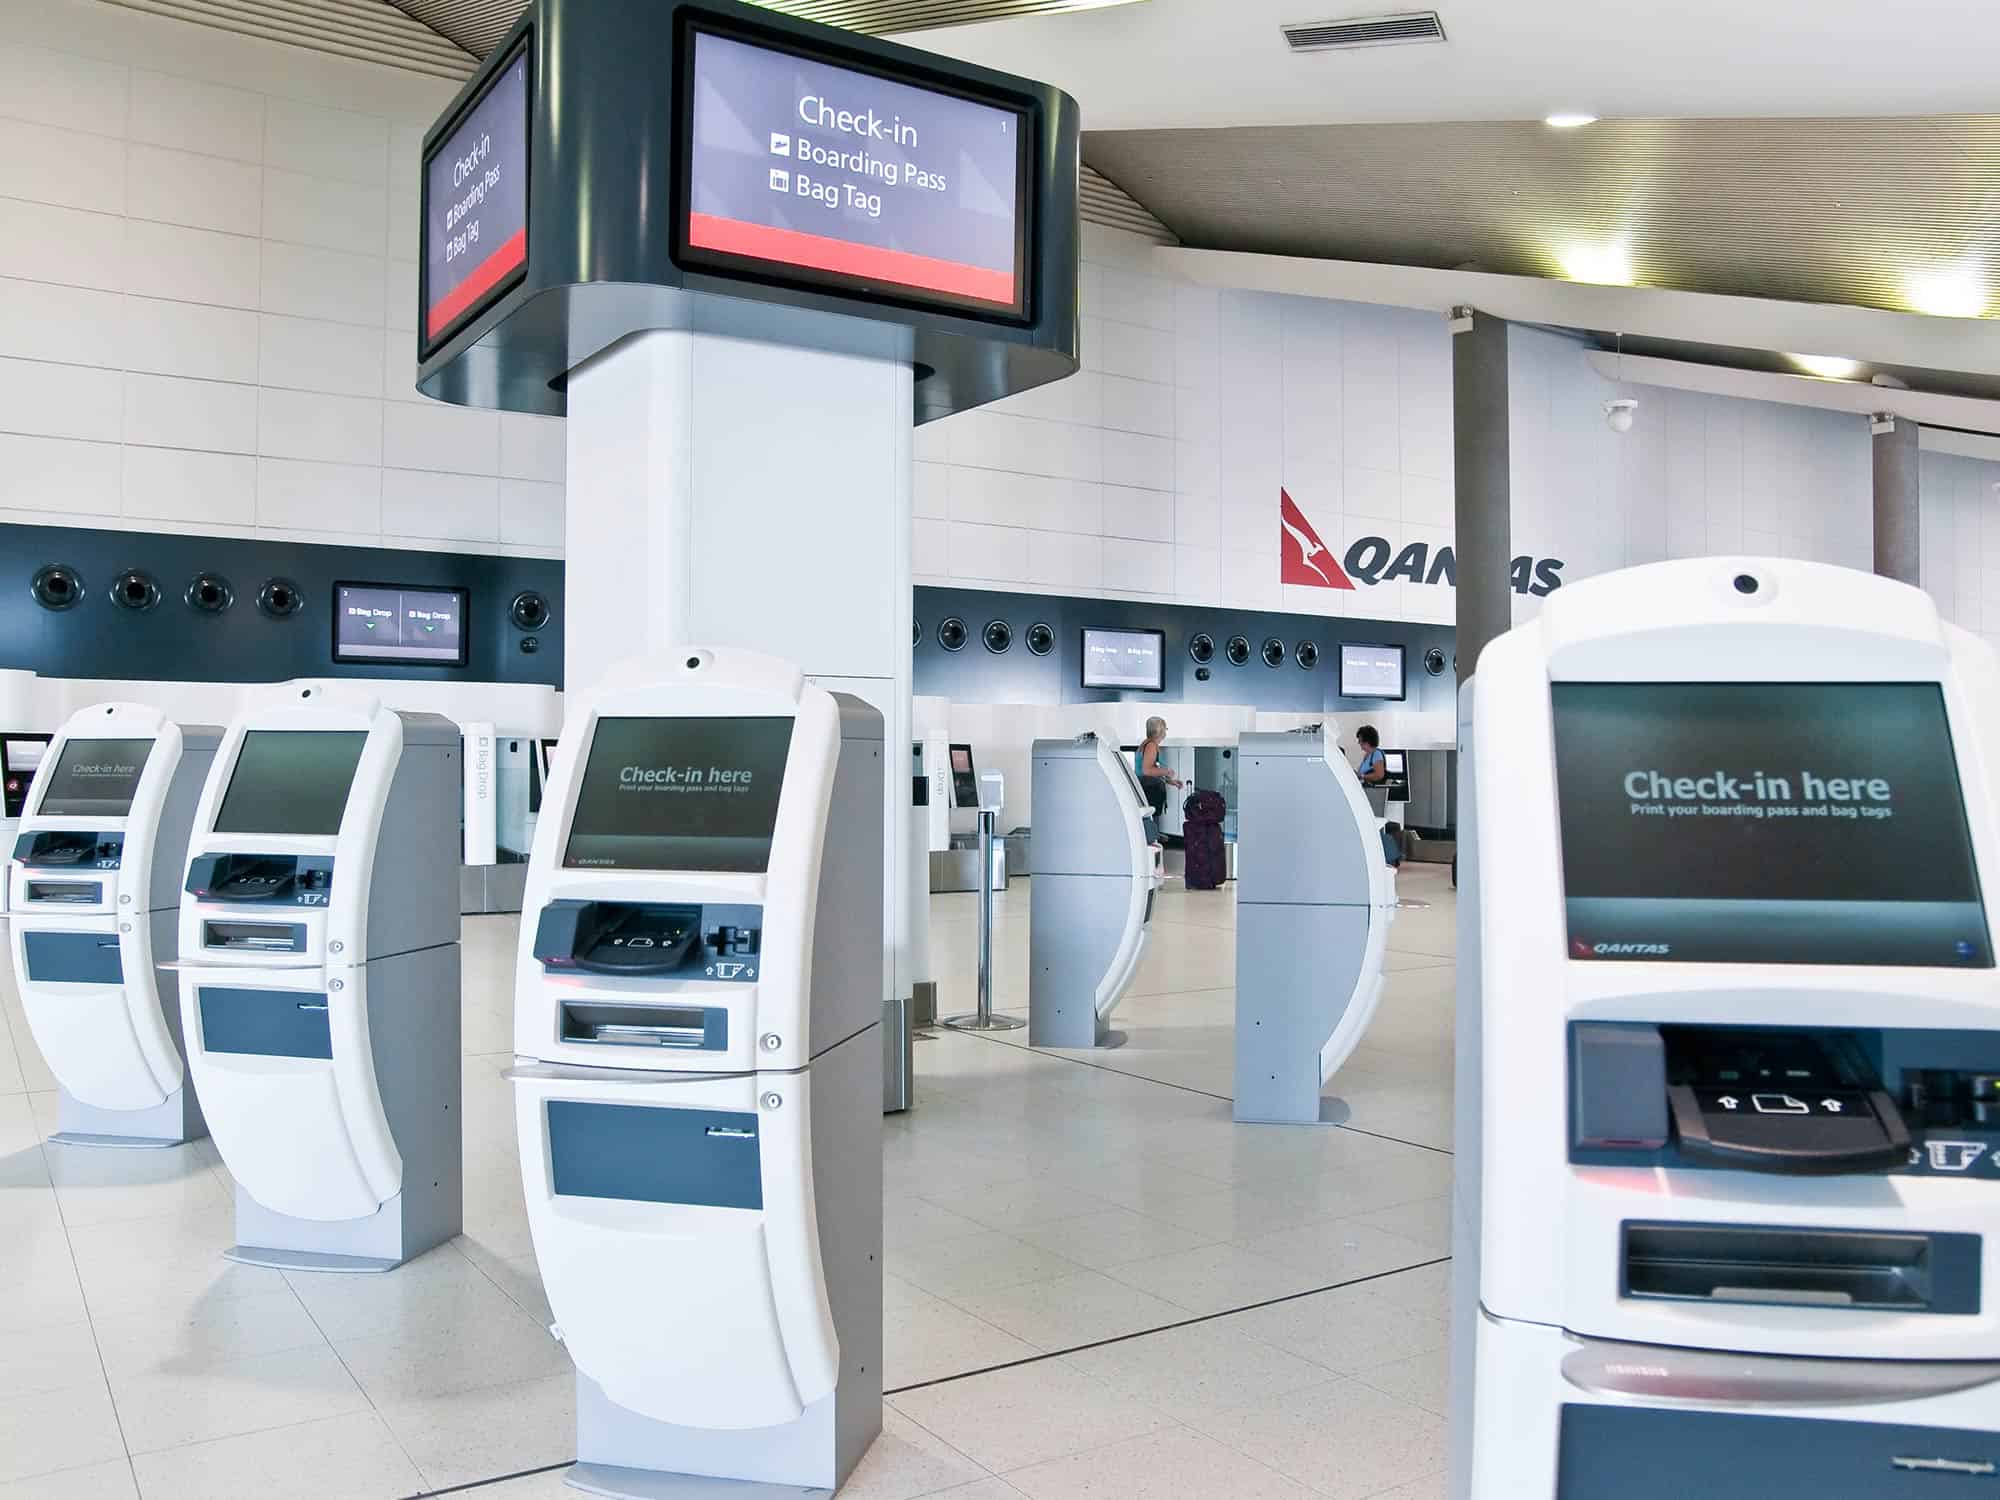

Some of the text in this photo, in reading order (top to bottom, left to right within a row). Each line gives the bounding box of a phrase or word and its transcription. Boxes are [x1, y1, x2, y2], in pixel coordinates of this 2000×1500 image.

[799, 95, 918, 147] Check-in
[1001, 121, 1007, 133] 1
[453, 132, 490, 188] Check-in
[797, 138, 946, 192] Boarding Pass
[453, 163, 501, 225] Boarding Pass
[796, 174, 881, 217] Bag Tag
[453, 220, 479, 257] Bag Tag
[1344, 536, 1564, 597] QANAS
[357, 607, 393, 618] Bag Drop
[620, 766, 753, 783] Check-in here
[1624, 770, 1891, 801] Check-in here
[1631, 803, 1892, 819] Print your boarding pass and bag tags
[1593, 943, 1670, 955] QANTAS
